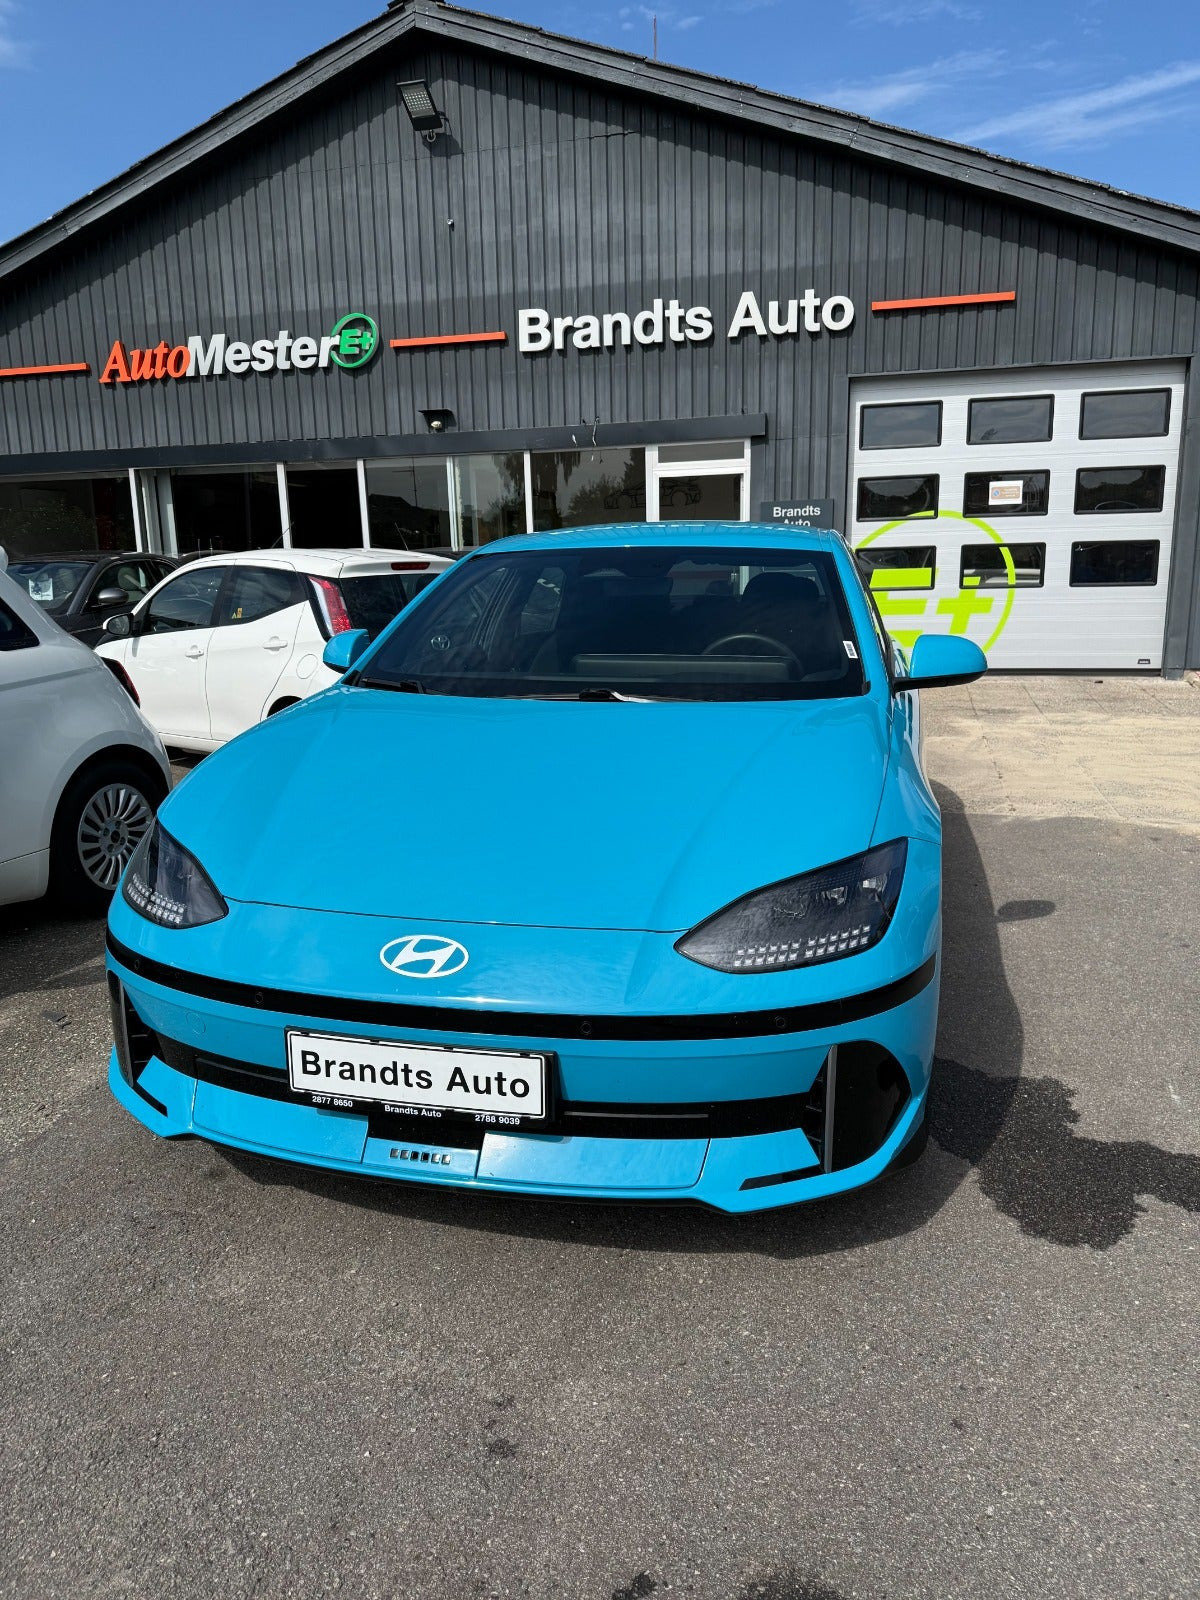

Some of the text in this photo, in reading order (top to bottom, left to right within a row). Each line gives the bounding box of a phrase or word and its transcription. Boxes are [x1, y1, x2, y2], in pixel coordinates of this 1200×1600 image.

[518, 288, 855, 352] Brandts Auto
[99, 330, 340, 383] AutoMester
[773, 505, 821, 518] Brandts
[300, 1049, 531, 1099] Brandts Auto
[333, 1098, 353, 1108] 8650
[384, 1104, 442, 1118] Brandts Auto
[474, 1114, 520, 1125] 2788 9039
